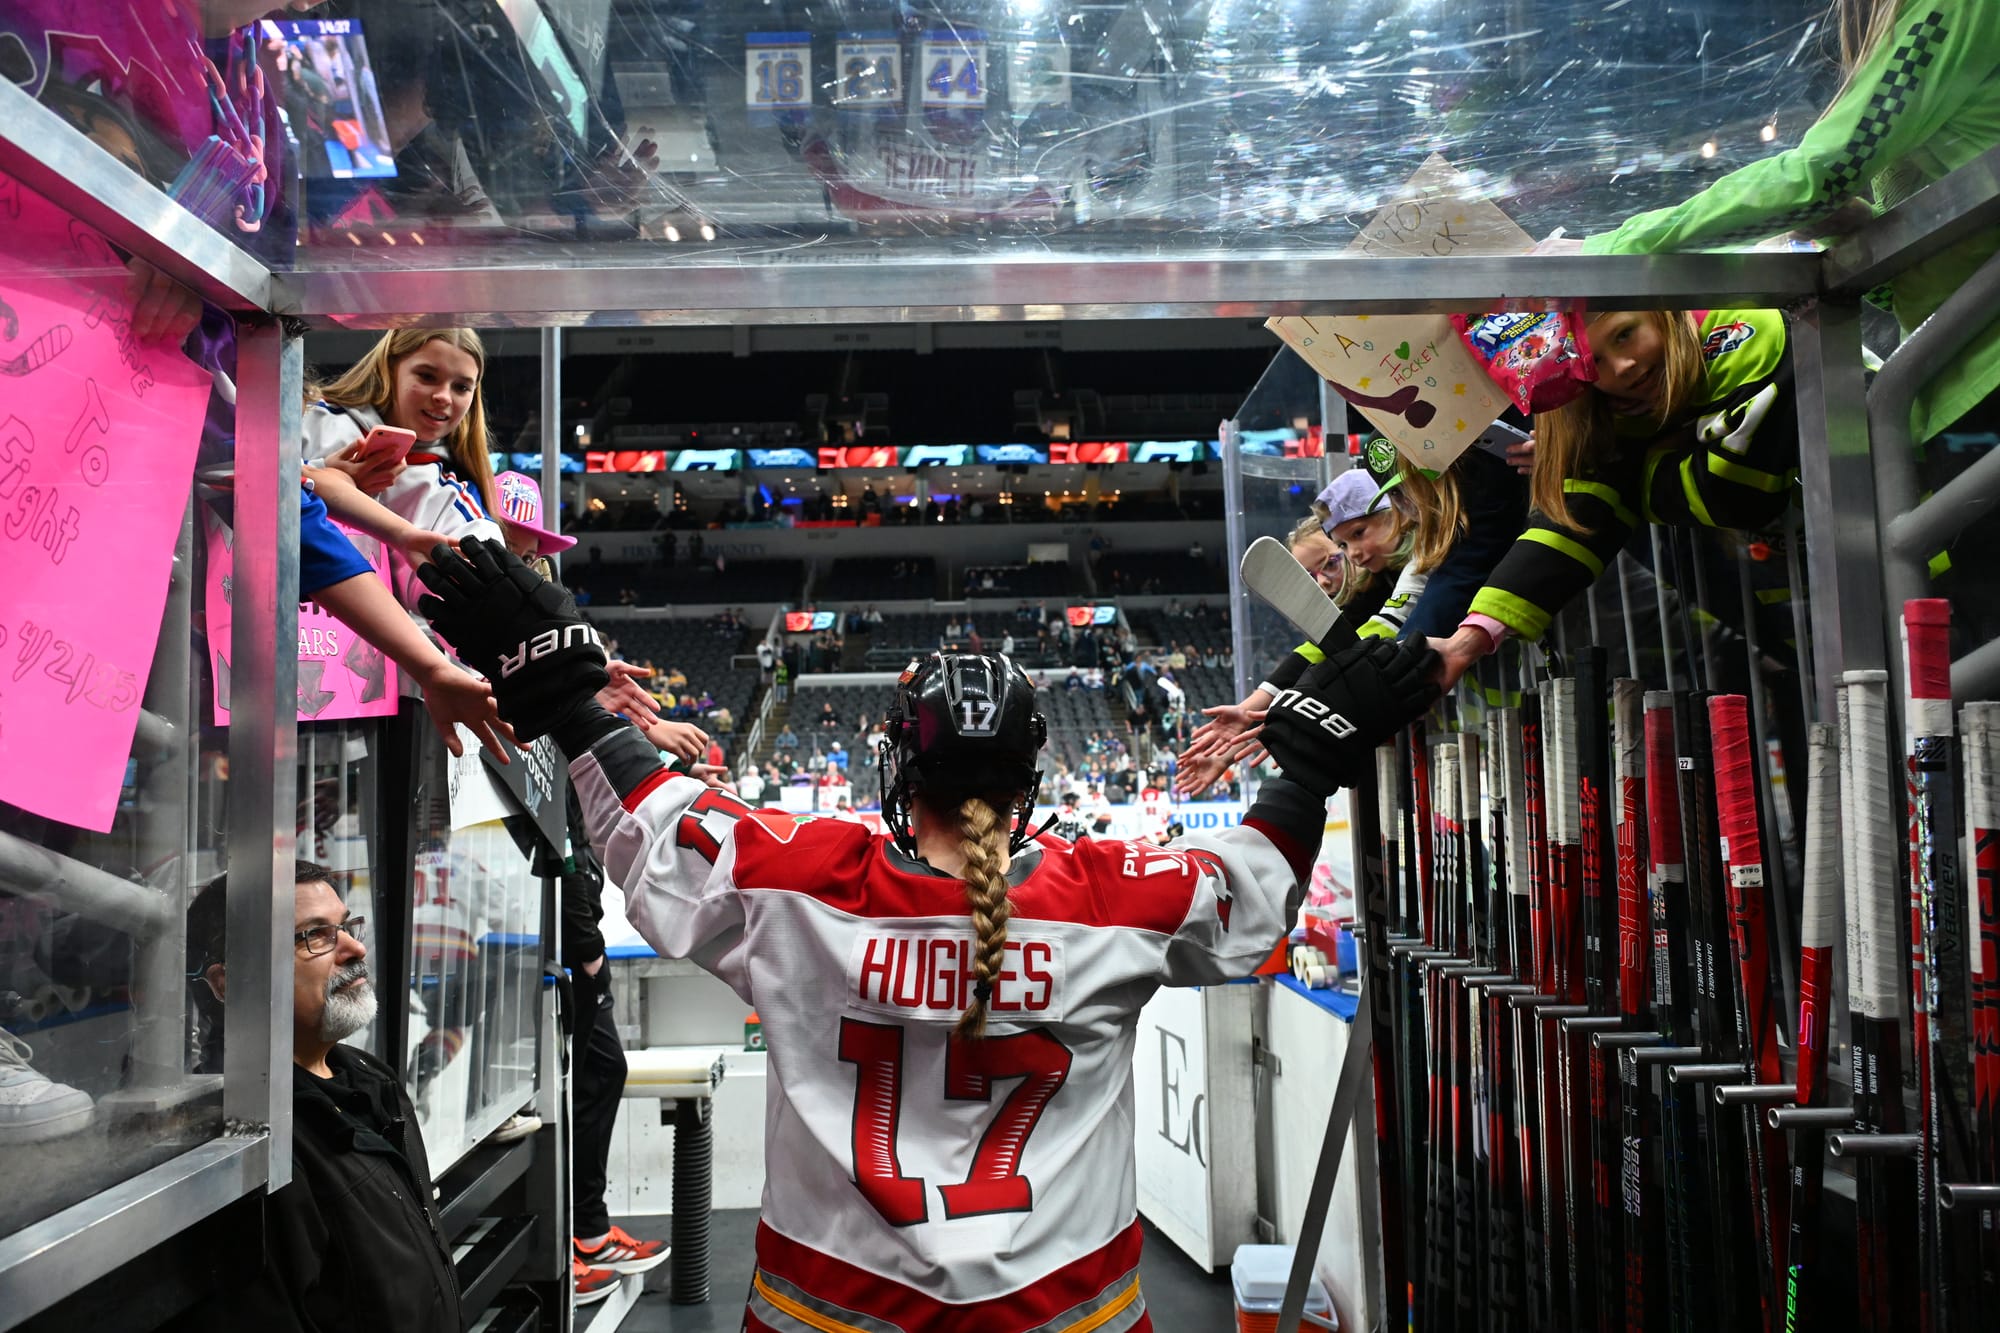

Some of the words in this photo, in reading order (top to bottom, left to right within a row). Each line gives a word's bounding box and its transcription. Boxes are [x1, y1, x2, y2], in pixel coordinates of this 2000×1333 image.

[756, 60, 803, 102] 16
[927, 58, 983, 98] 44
[1383, 191, 1441, 243] FOR
[1379, 353, 1401, 377] I
[1393, 341, 1439, 386] HOCKEY
[961, 700, 997, 731] 17
[1679, 760, 1689, 769] 27
[1942, 853, 1957, 936] BAUER
[859, 938, 1053, 1011] HUGHES
[1695, 939, 1705, 995] DARKANGELO
[1706, 943, 1716, 999] DARKANGELO
[1853, 1045, 1864, 1095] SAVOLAINEN
[1868, 1053, 1878, 1095] SAVOLAINEN
[838, 1016, 1074, 1228] 17
[1624, 1147, 1632, 1212] BAUER
[1632, 1147, 1641, 1215] BAUER
[1917, 1130, 1926, 1203] SERDACHNY
